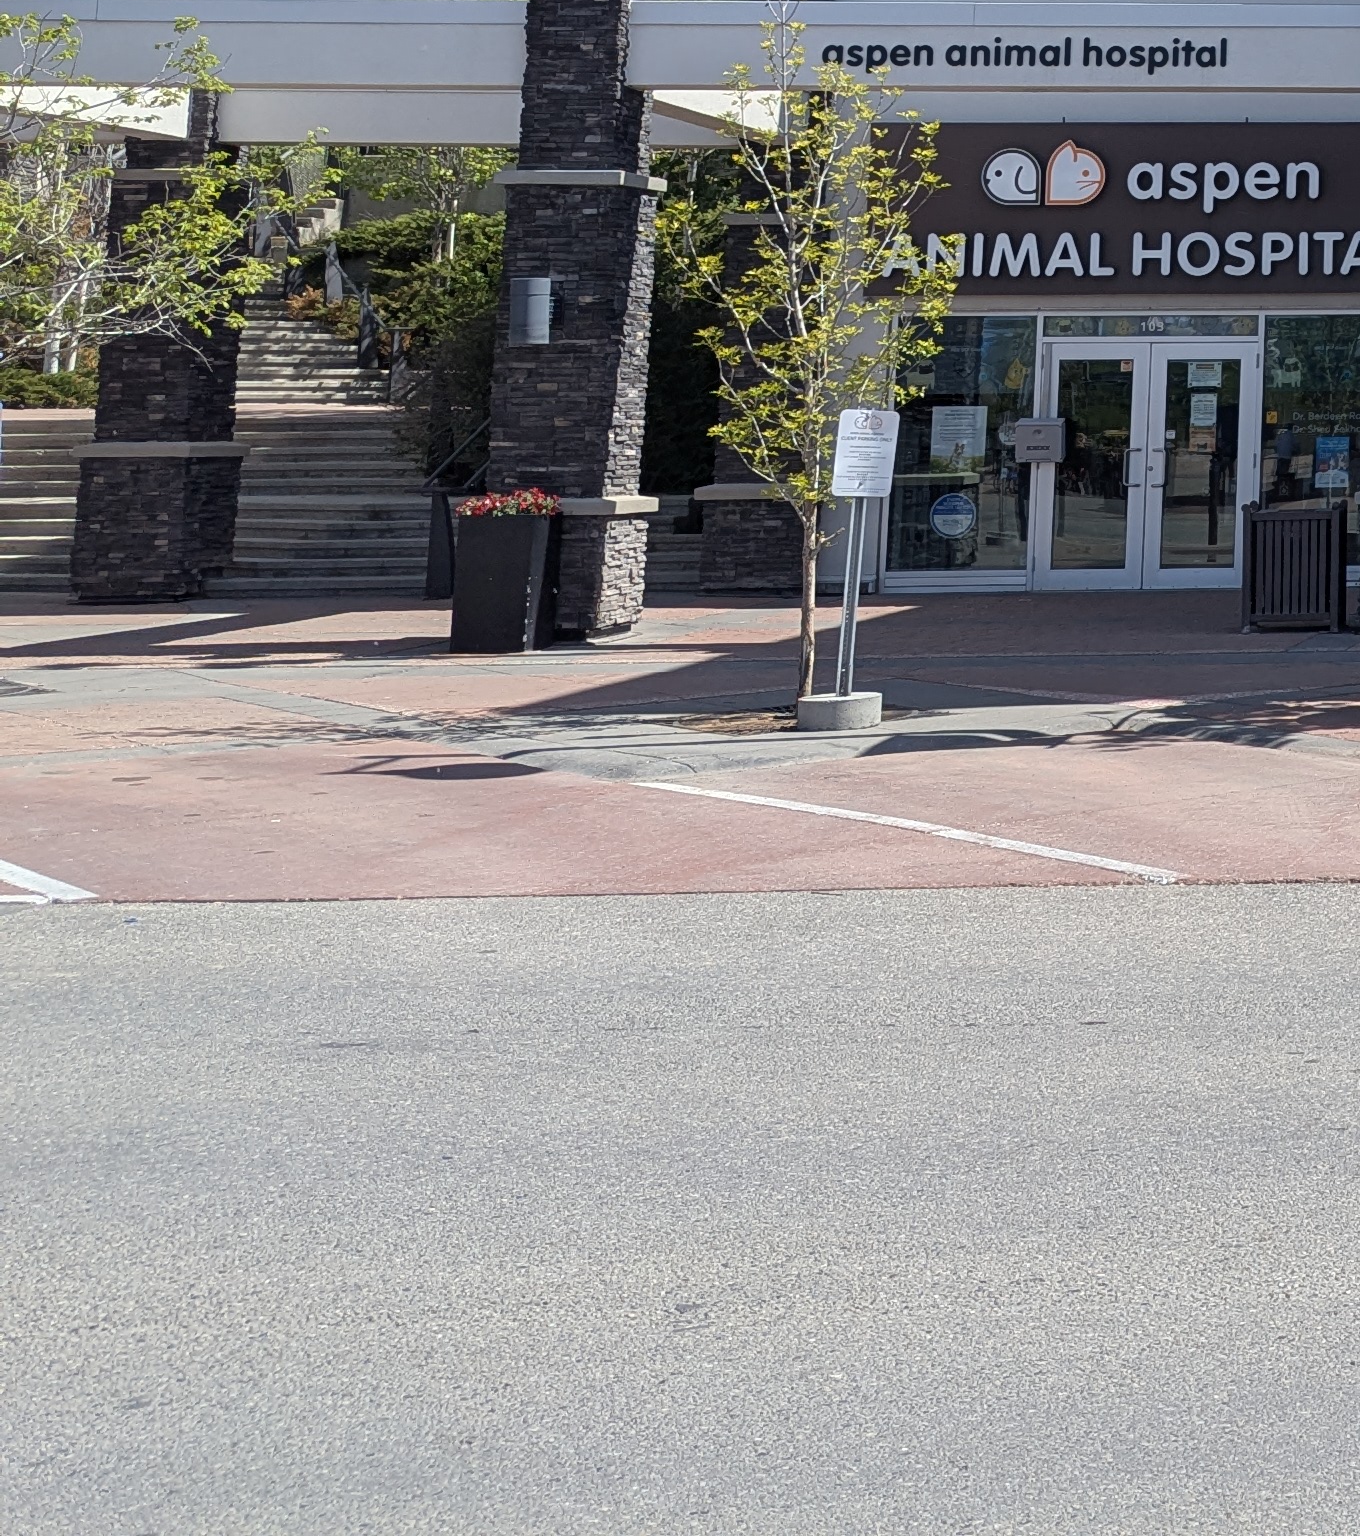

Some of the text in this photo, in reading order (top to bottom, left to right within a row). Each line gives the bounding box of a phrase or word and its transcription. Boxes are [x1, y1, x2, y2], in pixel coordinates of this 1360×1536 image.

[821, 36, 1228, 75] aspen animal hospital
[1126, 160, 1321, 214] aspen
[882, 230, 1115, 277] ANIMAL
[1140, 321, 1164, 333] 103
